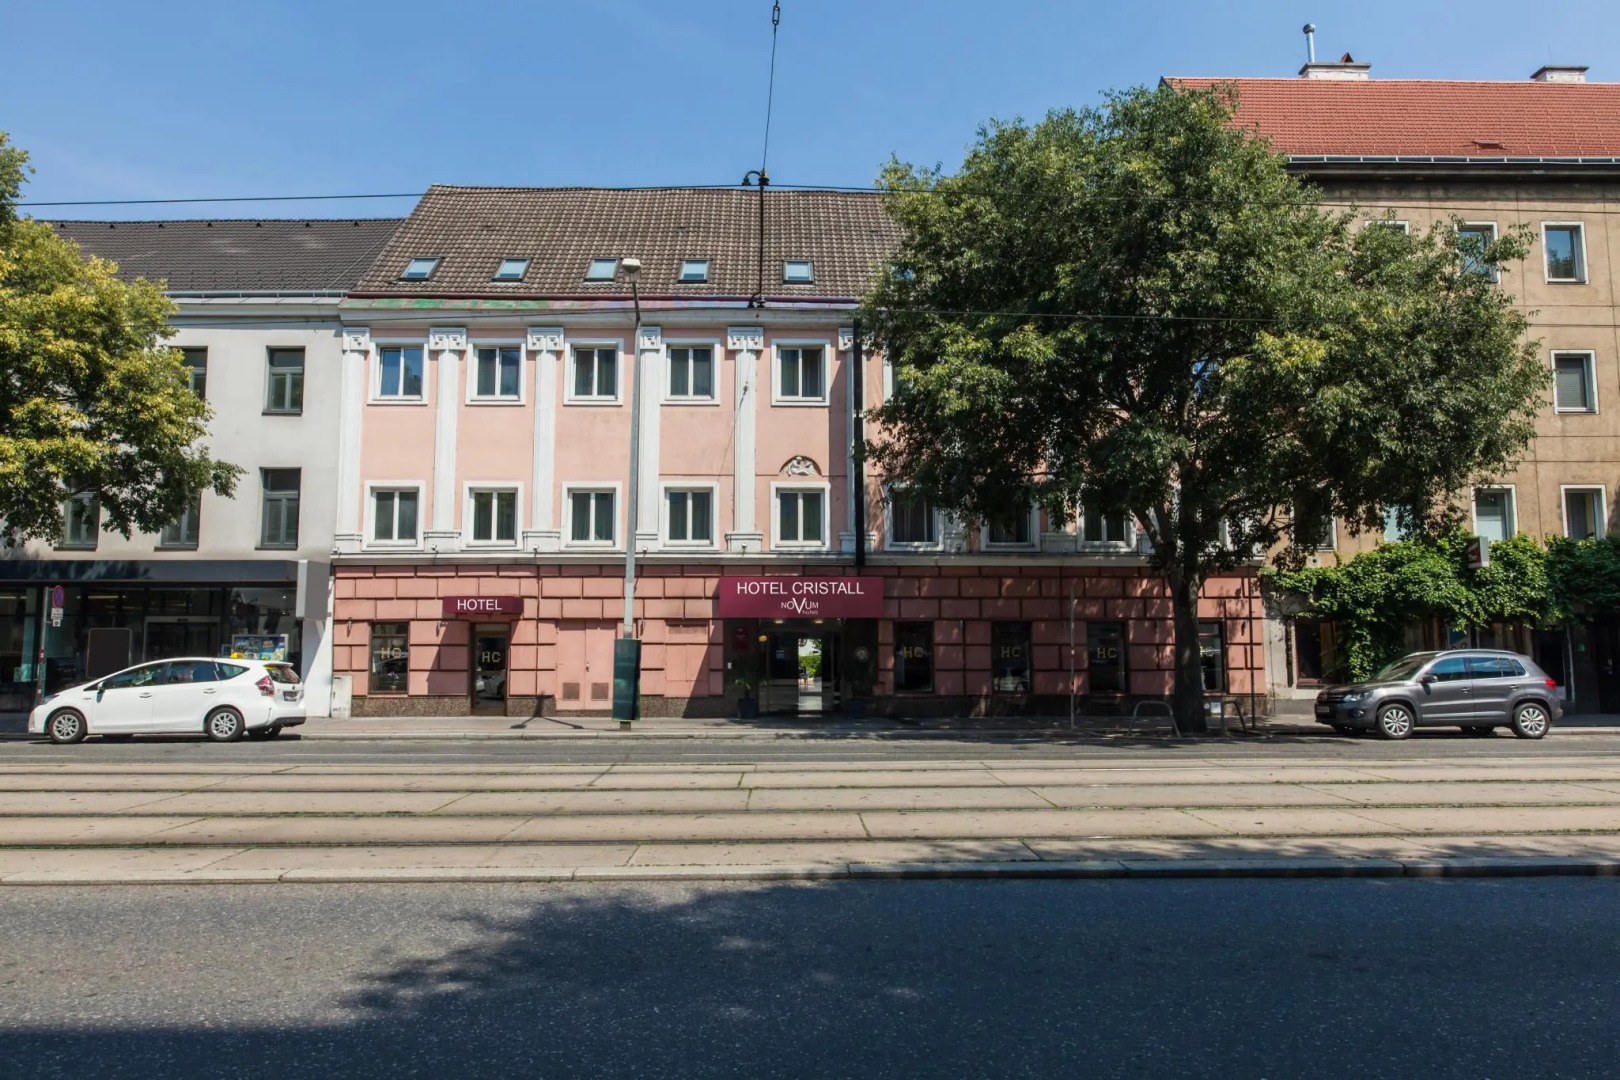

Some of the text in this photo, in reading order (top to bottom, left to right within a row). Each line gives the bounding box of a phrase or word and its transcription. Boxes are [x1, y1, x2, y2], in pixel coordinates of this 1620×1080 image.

[737, 582, 865, 595] HOTEL CRISTALL
[457, 599, 503, 611] HOTEL
[780, 598, 819, 614] NOVUM
[481, 651, 501, 663] HC
[1001, 646, 1021, 658] HC
[1097, 647, 1118, 659] HC
